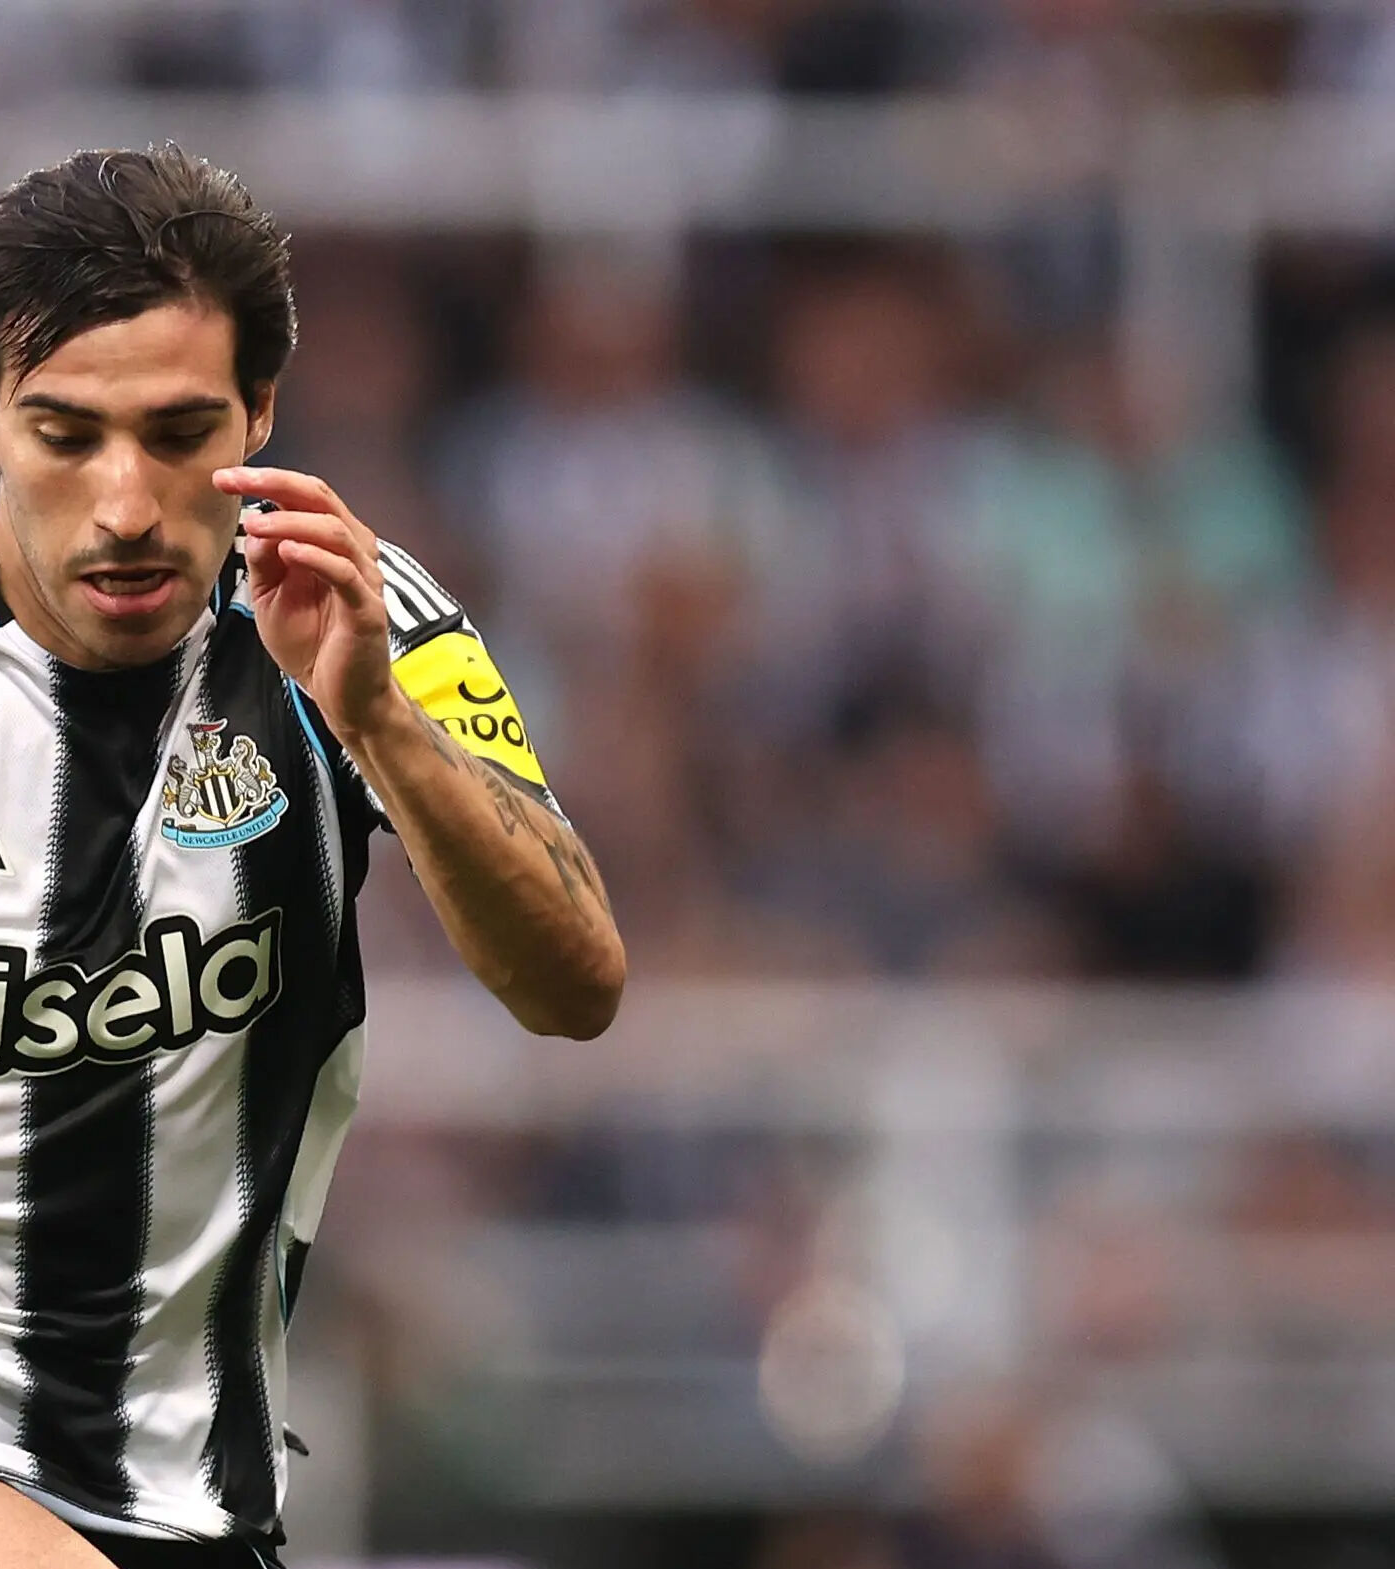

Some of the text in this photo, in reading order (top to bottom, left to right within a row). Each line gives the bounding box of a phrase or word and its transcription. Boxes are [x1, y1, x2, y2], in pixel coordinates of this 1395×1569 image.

[438, 713, 532, 754] noo
[181, 814, 273, 845] NEWCASTLE UNITED
[13, 926, 273, 1060] sela
